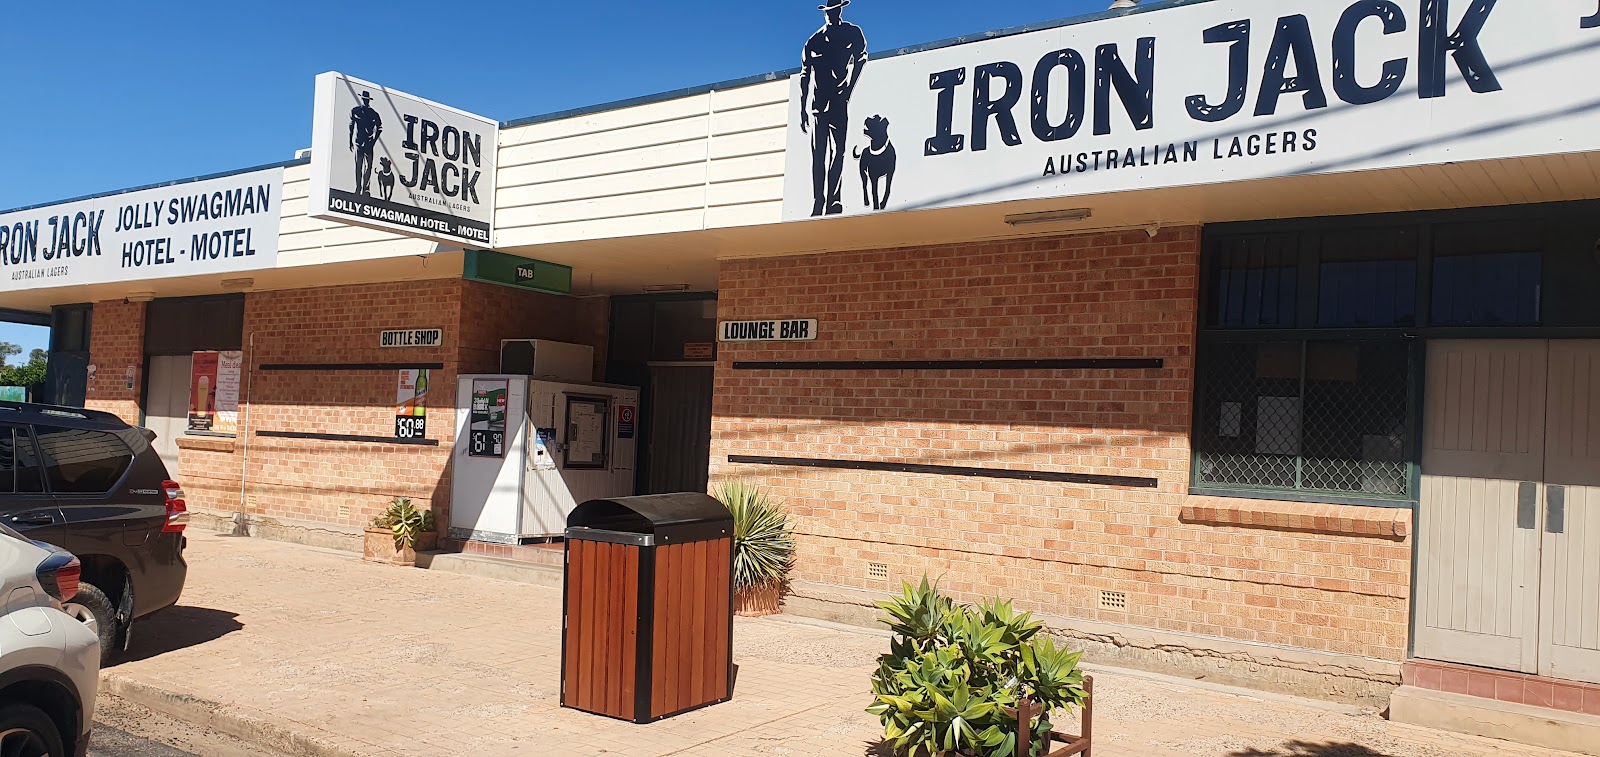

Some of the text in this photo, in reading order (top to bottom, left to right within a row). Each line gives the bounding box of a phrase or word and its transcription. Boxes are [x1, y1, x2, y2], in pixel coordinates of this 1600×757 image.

[924, 0, 1503, 156] IRON JACK
[402, 114, 481, 167] IRON
[1043, 128, 1318, 176] AUSTRALIAN LAGERS
[400, 153, 481, 204] JACK
[408, 192, 447, 208] AUSTRALIAN
[115, 184, 271, 232] JOLLY SWAGMAN
[329, 197, 361, 213] JOLLY
[363, 203, 418, 227] SWAGMAN
[420, 217, 450, 233] HOTEL
[457, 225, 489, 241] MOTEL
[0, 210, 104, 266] RON JACK
[121, 237, 175, 268] HOTEL
[190, 227, 256, 261] MOTEL
[11, 265, 69, 280] AUSTRALIAN LAGERS
[516, 267, 534, 279] TAB
[382, 330, 439, 346] BOTTLE SHOP
[724, 320, 809, 340] LOUNGE BAR
